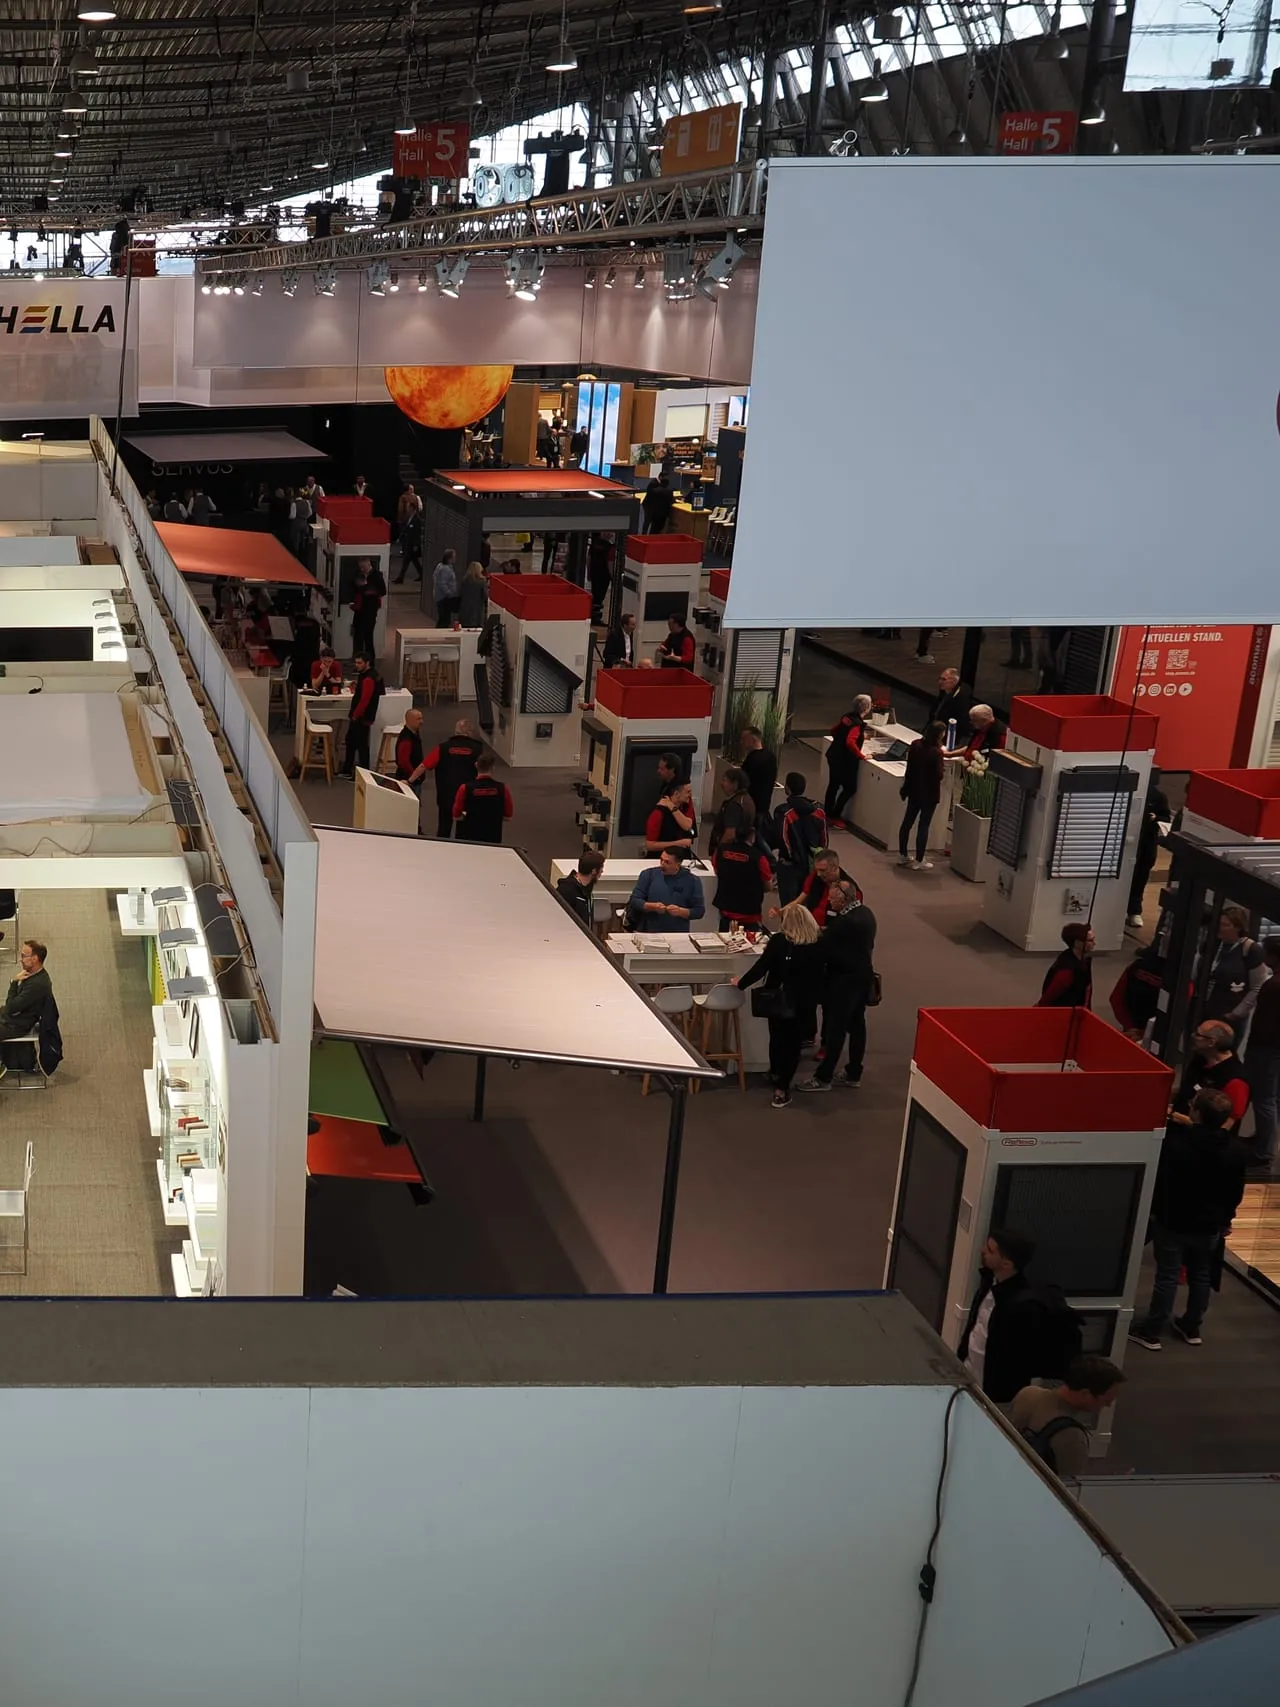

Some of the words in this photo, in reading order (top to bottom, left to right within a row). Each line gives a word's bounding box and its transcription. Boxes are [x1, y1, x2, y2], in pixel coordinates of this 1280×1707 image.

[1005, 118, 1038, 131] Halle
[1042, 118, 1061, 150] 5
[434, 129, 456, 160] 5
[1003, 137, 1028, 151] Hall
[399, 147, 424, 161] Hall
[1141, 632, 1191, 643] AKTUELLEN
[1192, 632, 1224, 642] STAND.
